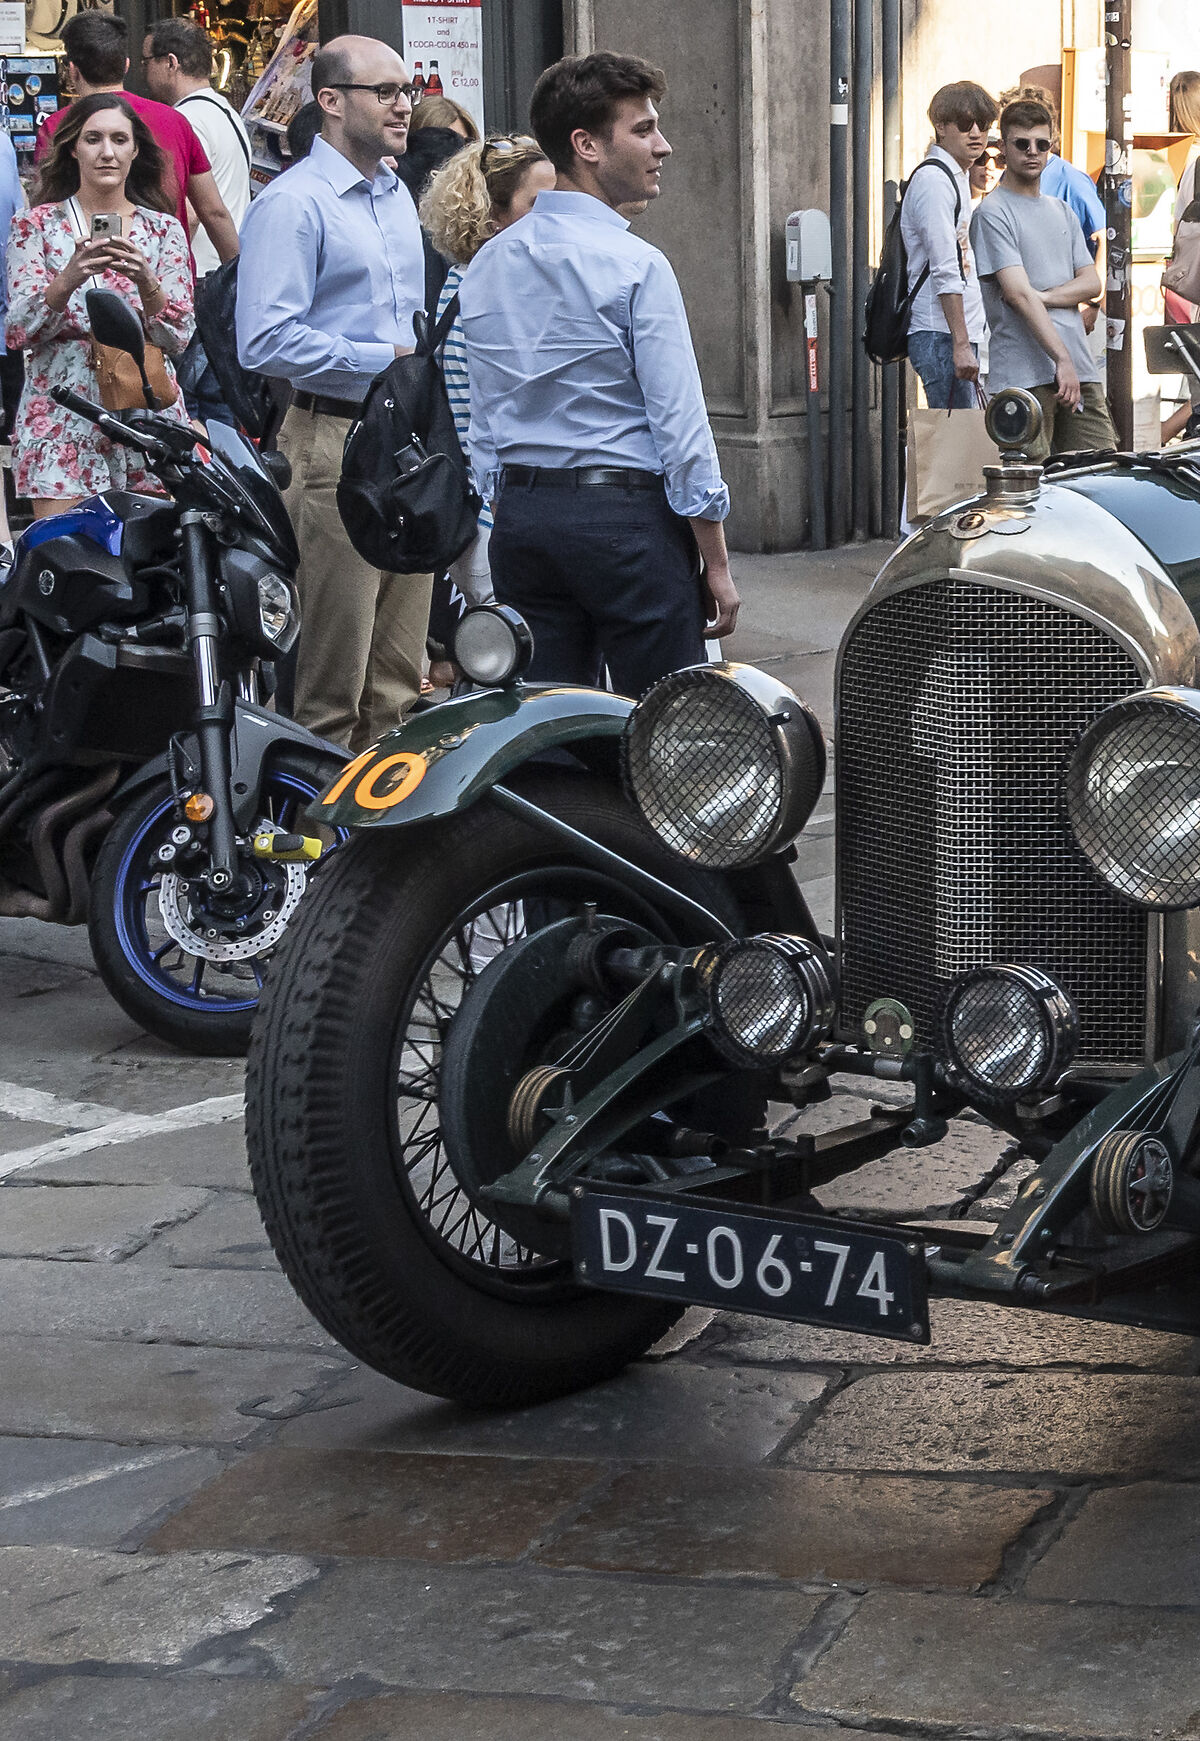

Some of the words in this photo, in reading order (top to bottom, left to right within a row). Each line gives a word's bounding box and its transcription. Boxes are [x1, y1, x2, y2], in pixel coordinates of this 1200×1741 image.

[413, 41, 456, 49] COCA-COLA
[457, 41, 469, 49] 450
[470, 41, 479, 49] ml
[321, 750, 427, 810] 10
[599, 1208, 895, 1316] DZ-06-74
